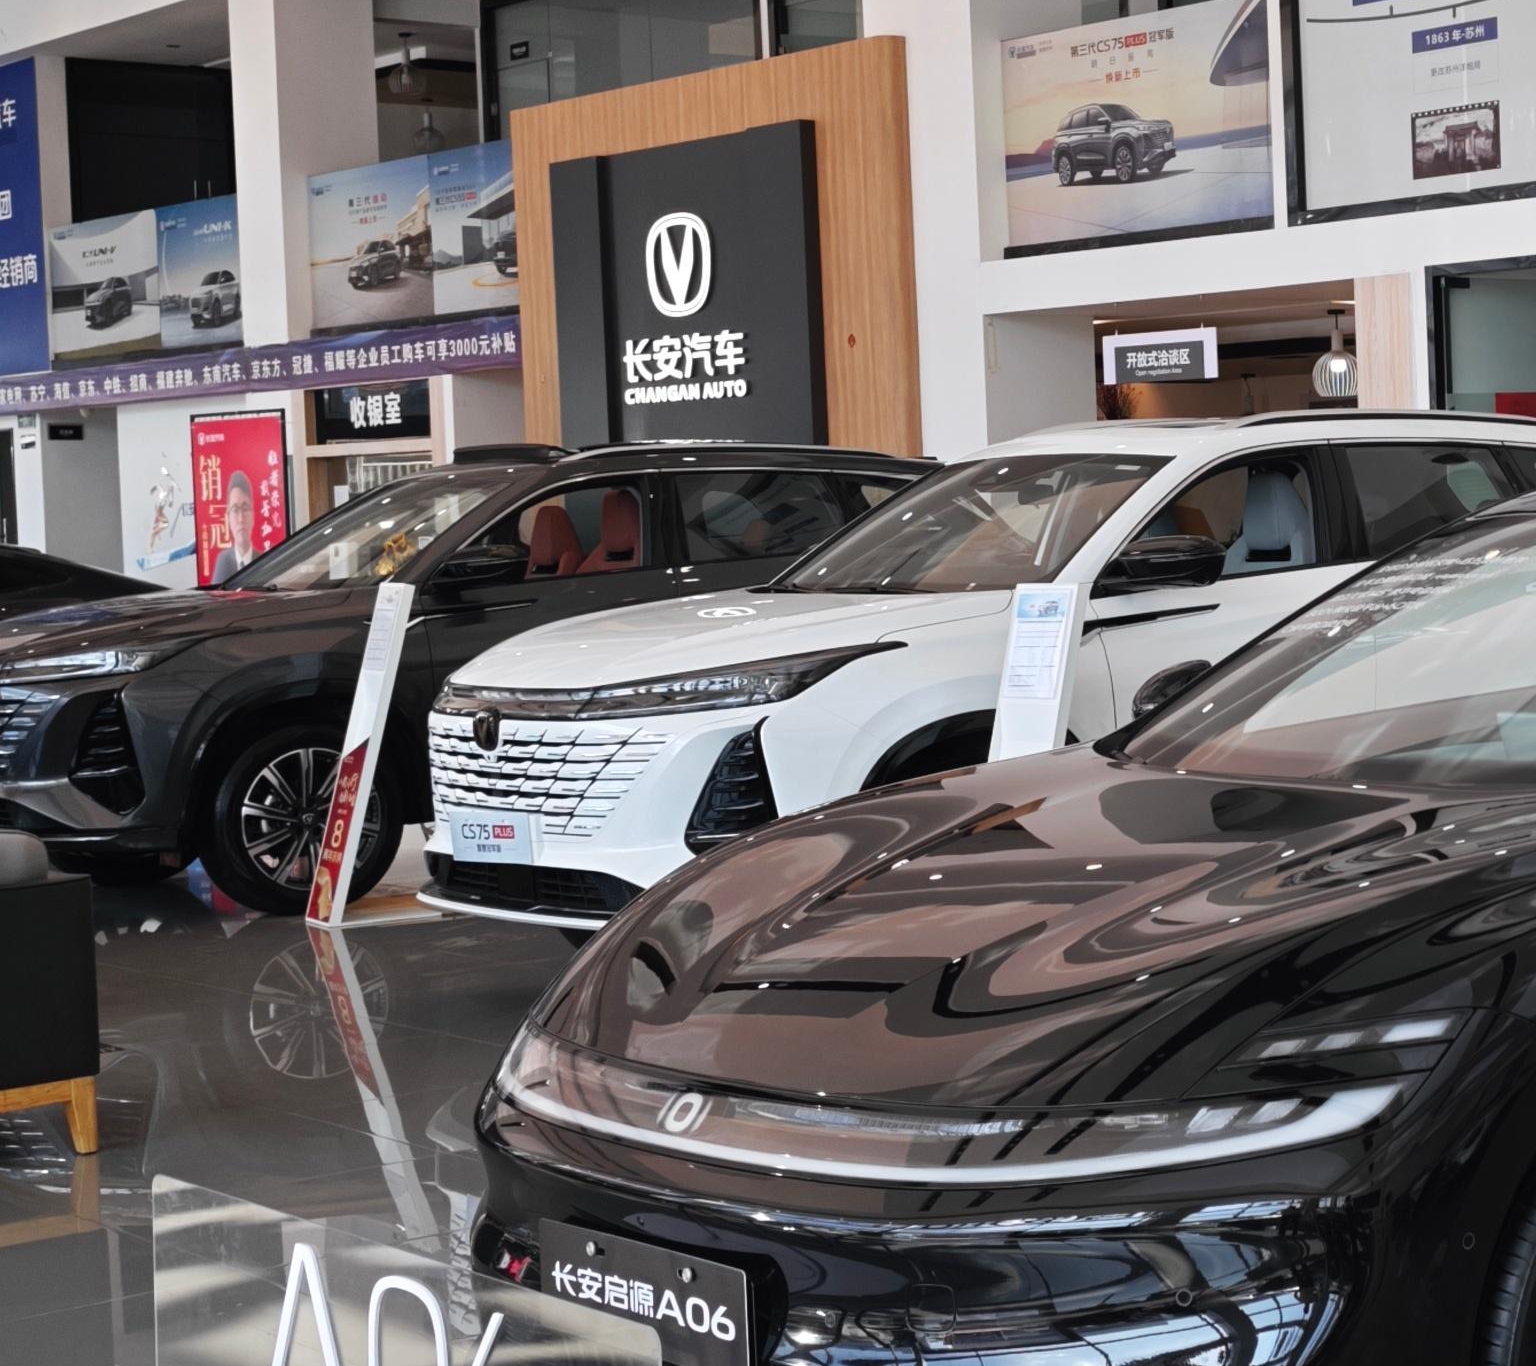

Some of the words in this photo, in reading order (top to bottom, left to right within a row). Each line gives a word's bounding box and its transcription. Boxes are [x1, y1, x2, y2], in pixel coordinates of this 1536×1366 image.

[0, 98, 16, 128] 车
[623, 330, 746, 383] 长安汽车
[1126, 348, 1190, 369] 开放式洽谈区
[624, 383, 700, 405] CHANGAN
[702, 379, 747, 400] AUTO
[350, 392, 402, 429] 收银室
[331, 819, 344, 848] 8
[461, 823, 490, 840] CS75
[493, 826, 514, 837] PLUS
[551, 1260, 736, 1341] 长安启源A06
